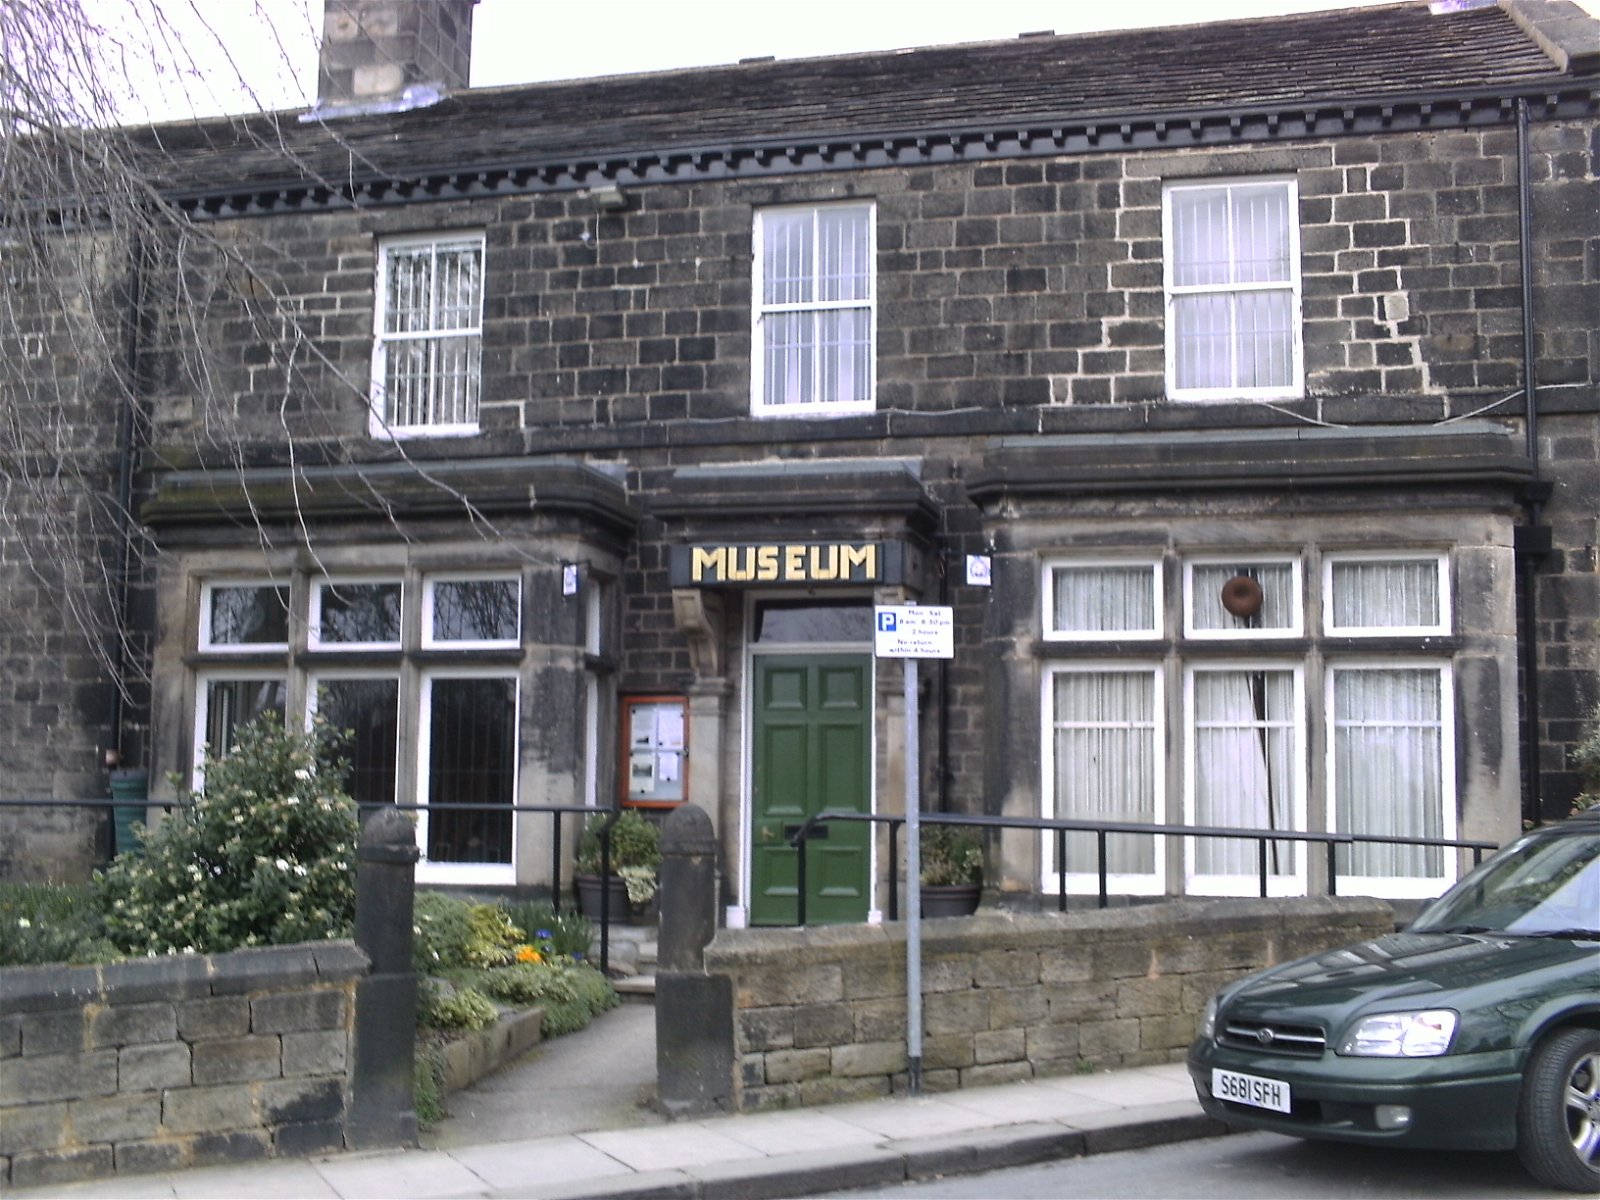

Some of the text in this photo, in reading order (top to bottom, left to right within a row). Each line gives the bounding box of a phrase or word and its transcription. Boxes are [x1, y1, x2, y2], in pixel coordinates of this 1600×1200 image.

[692, 544, 876, 581] MUSEUM
[881, 613, 895, 632] P
[1221, 1075, 1281, 1107] S681 SFH
